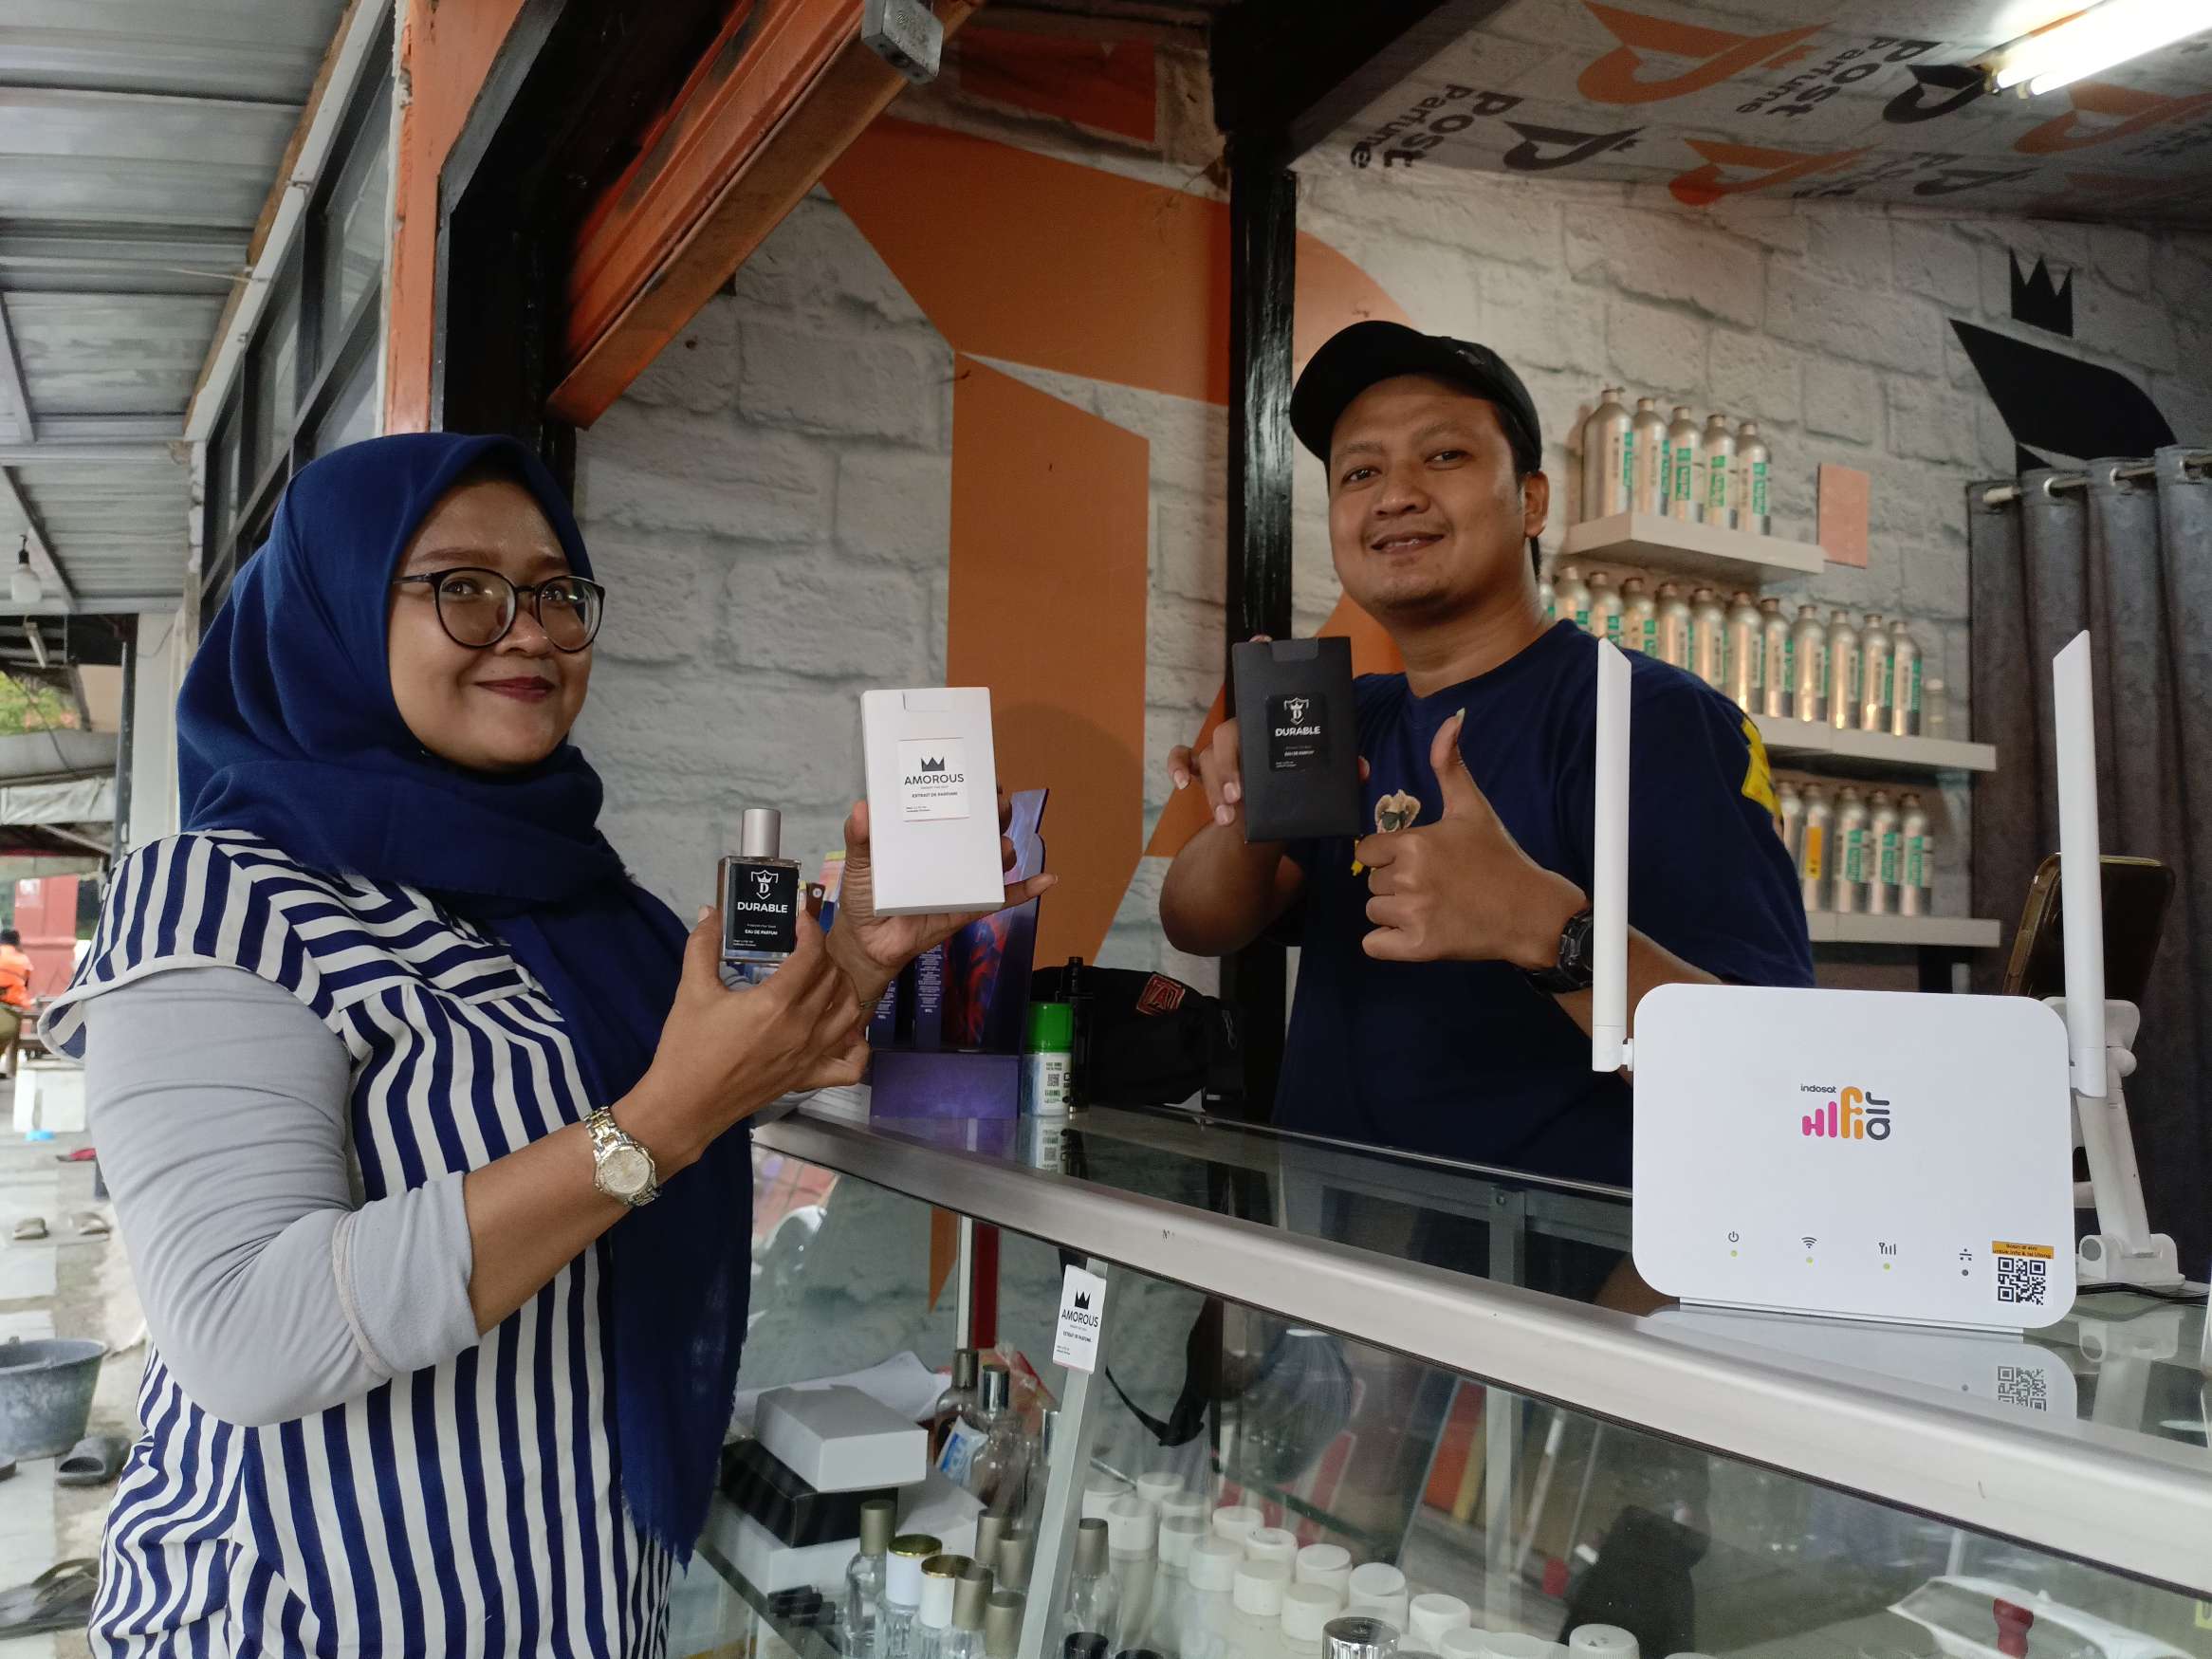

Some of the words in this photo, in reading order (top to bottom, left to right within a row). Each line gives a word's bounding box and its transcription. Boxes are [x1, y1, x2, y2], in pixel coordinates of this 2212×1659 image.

[1383, 91, 1524, 167] Post
[1275, 726, 1320, 736] DURABLE
[904, 774, 965, 785] AMOROUS
[737, 902, 788, 913] DURABLE
[1800, 1083, 1836, 1093] indosat
[1061, 1309, 1098, 1328] AMOROUS
